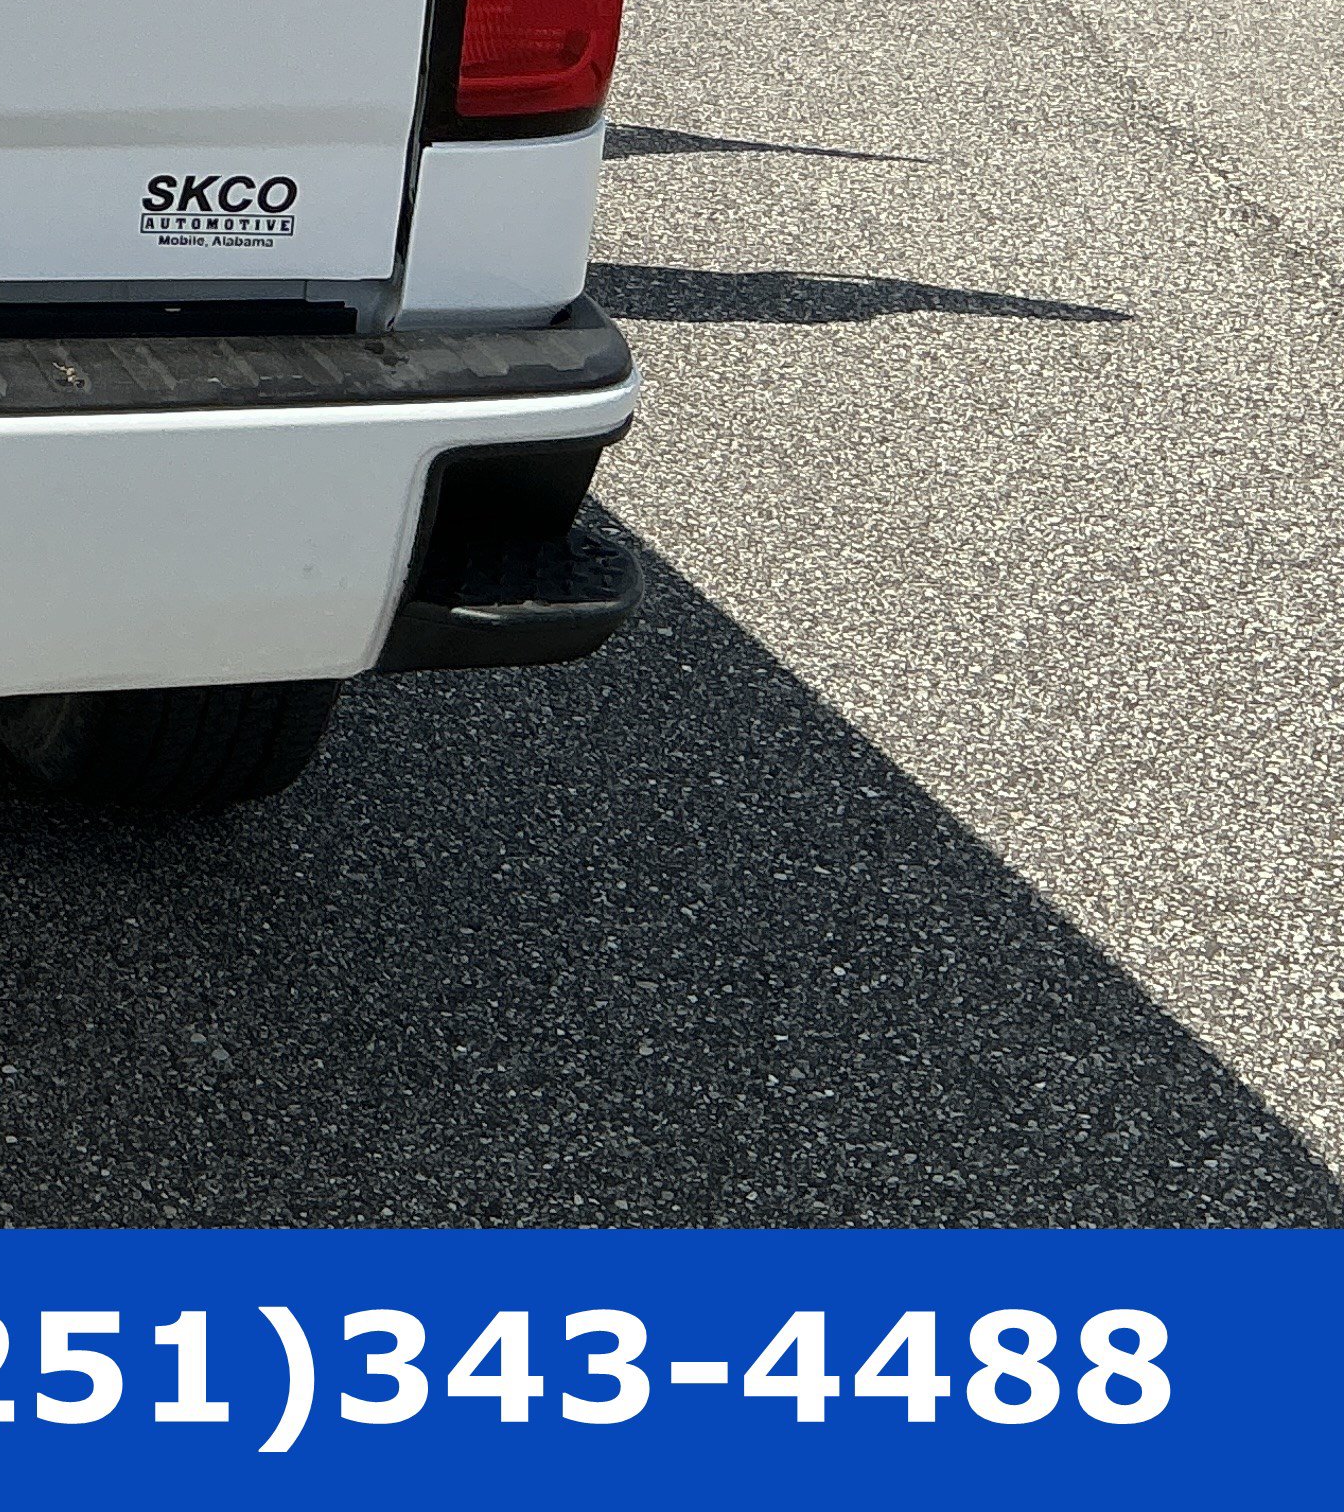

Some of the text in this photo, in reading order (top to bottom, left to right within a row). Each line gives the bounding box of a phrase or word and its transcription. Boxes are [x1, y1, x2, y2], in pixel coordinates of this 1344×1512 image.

[142, 174, 298, 213] SKCO
[145, 217, 291, 232] AUTOMOTIVE
[158, 235, 274, 248] Mobile, Alabama
